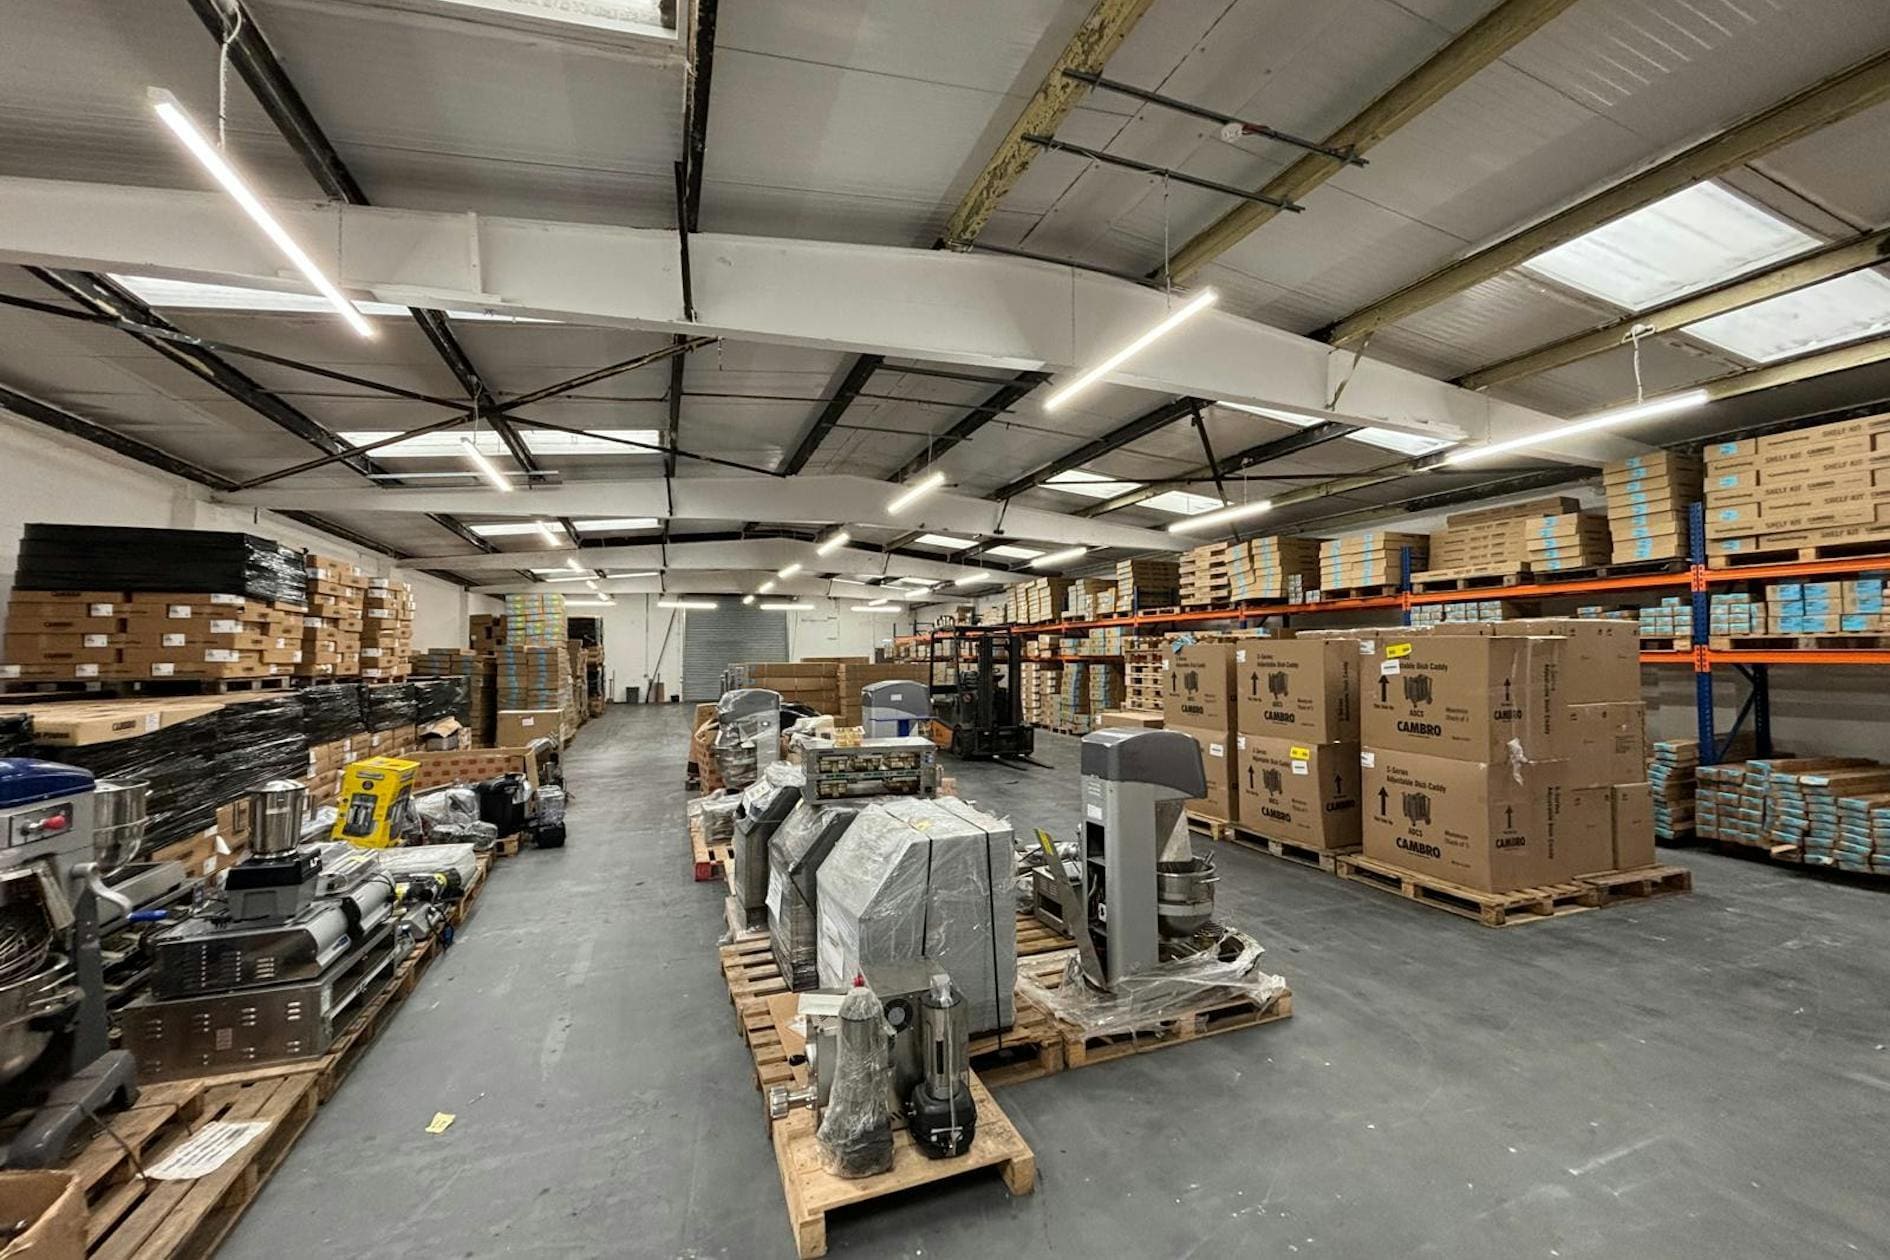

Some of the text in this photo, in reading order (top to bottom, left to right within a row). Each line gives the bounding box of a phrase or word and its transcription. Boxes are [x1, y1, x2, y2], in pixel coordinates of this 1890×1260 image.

[1181, 704, 1204, 715] CAMBRO
[1263, 710, 1296, 723] CAMBRO
[1397, 721, 1442, 736] CAMBRO
[1261, 806, 1292, 823] CAMBRO
[1396, 837, 1441, 859] CAMBRO
[1496, 836, 1526, 849] CAMBRO
